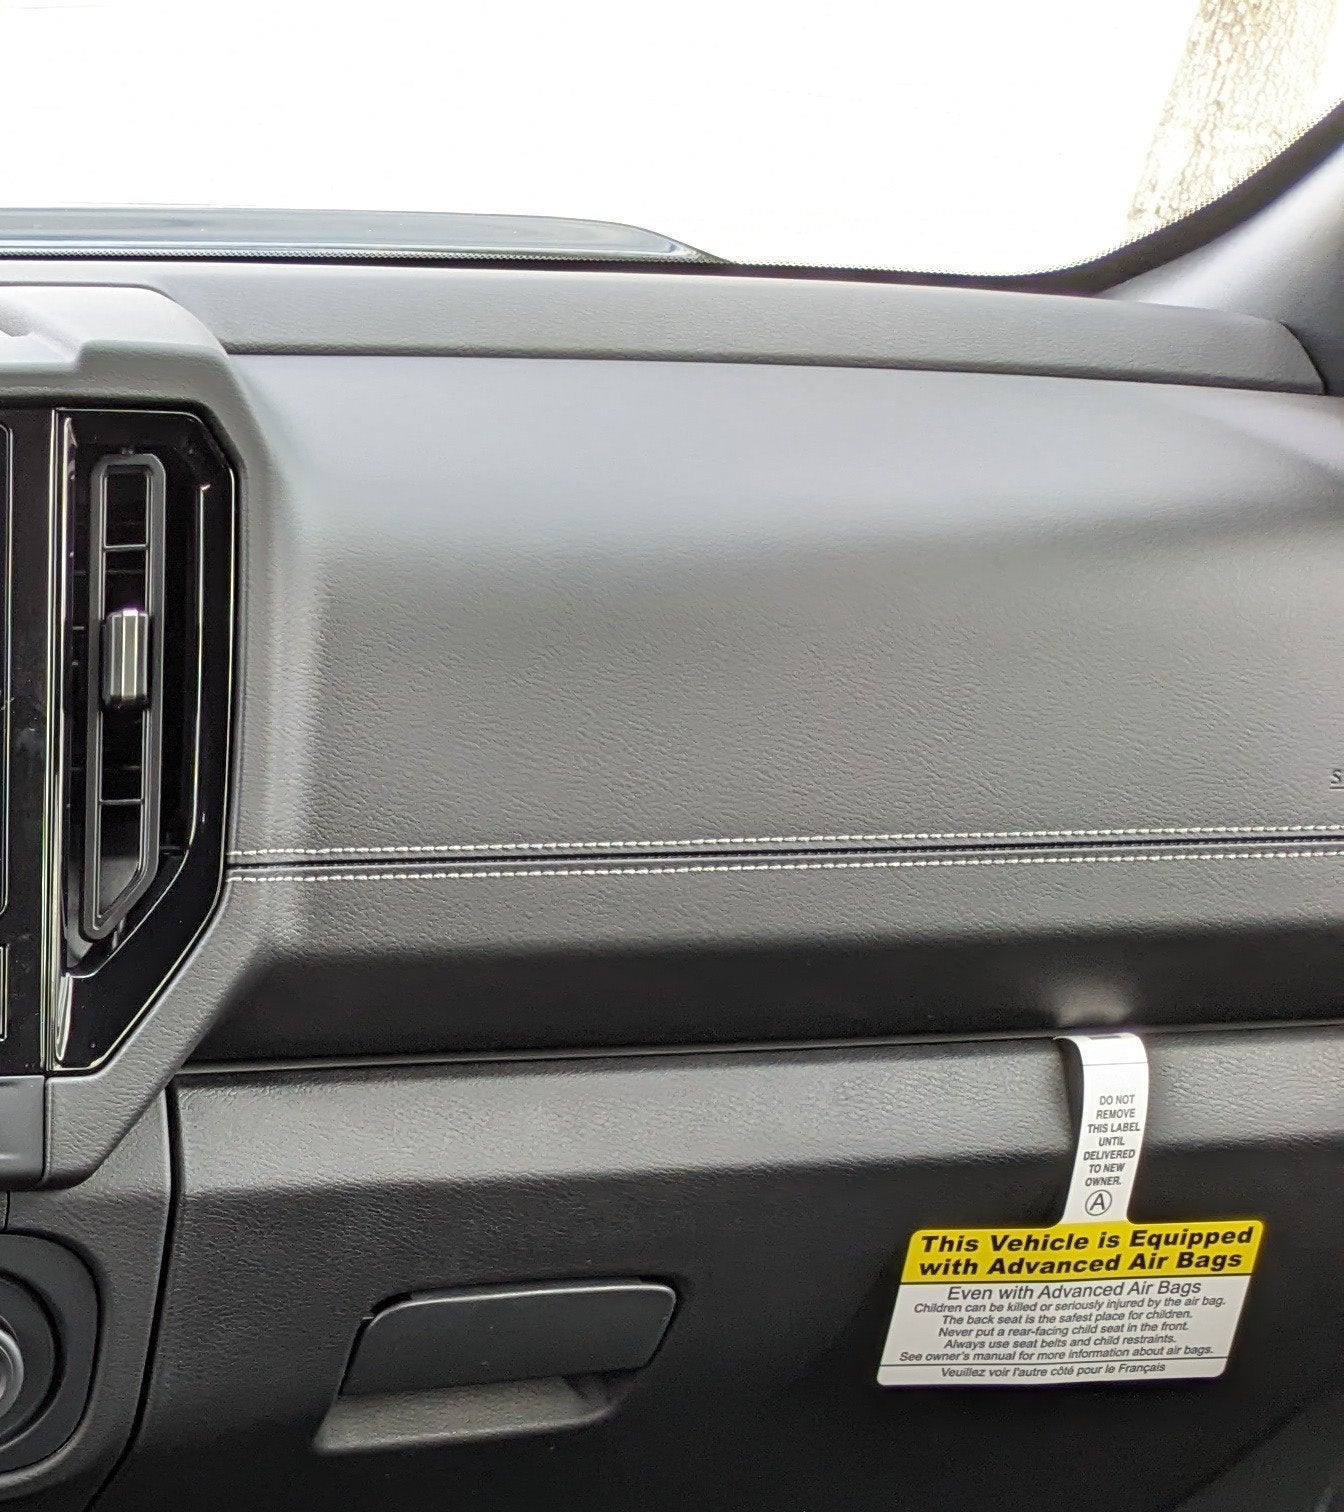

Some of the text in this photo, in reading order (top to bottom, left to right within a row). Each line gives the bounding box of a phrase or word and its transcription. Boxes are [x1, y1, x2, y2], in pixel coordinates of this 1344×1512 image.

[1099, 1094, 1135, 1106] DO NOT
[1095, 1108, 1135, 1120] REMOVE
[1087, 1121, 1140, 1134] THIS LABEL
[1098, 1136, 1125, 1147] UNTIL
[1083, 1148, 1136, 1161] DELIVERED
[1088, 1162, 1126, 1174] TO NEW
[1084, 1175, 1122, 1188] OWNER.
[921, 1226, 1254, 1254] This Vehicle is Equipped
[919, 1250, 1243, 1277] with Advanced Air Bags
[947, 1280, 1202, 1301] Even with Advanced Air Bags
[914, 1295, 1226, 1314] Children can be killed or seriously injured by the air bag.
[942, 1309, 1192, 1325] The back seat is the safest place for children.
[938, 1321, 1189, 1339] Never put a rear-facing child seat in the front.
[943, 1334, 1176, 1350] Always use seat belts and child restraints.
[899, 1345, 1213, 1361] See owner's manual for more information about air bags.
[941, 1362, 1166, 1378] Veuillez voir l'autre côté pour le Français
